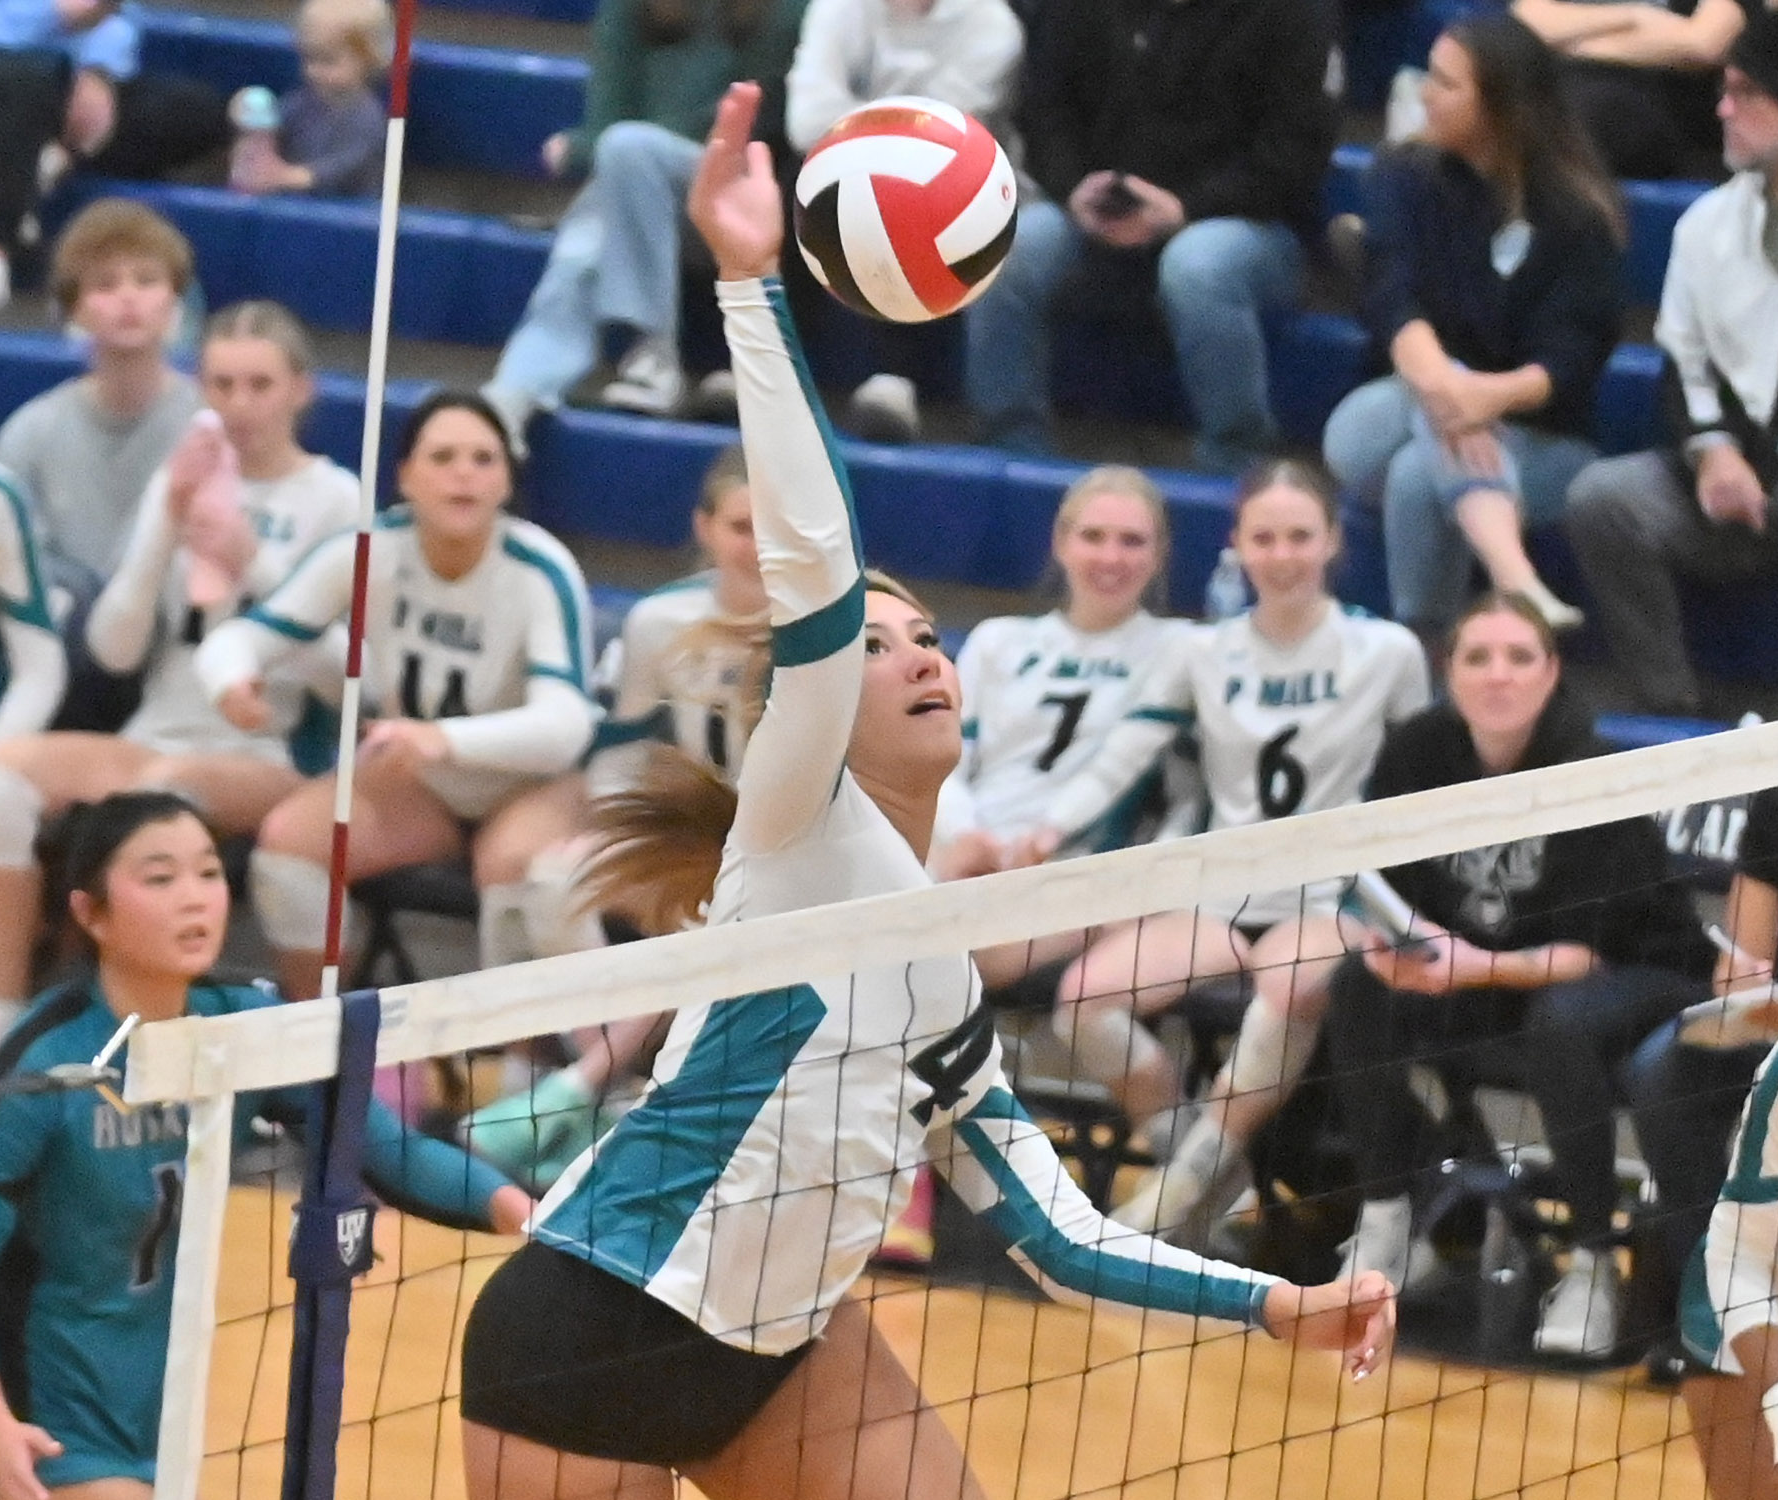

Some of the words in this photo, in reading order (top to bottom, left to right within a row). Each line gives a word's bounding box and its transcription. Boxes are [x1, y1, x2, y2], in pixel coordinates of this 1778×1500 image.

[1036, 689, 1092, 773] 7
[1225, 675, 1242, 705] P
[1257, 669, 1339, 707] MILL
[1257, 722, 1308, 819] 6
[906, 1003, 996, 1129] 4
